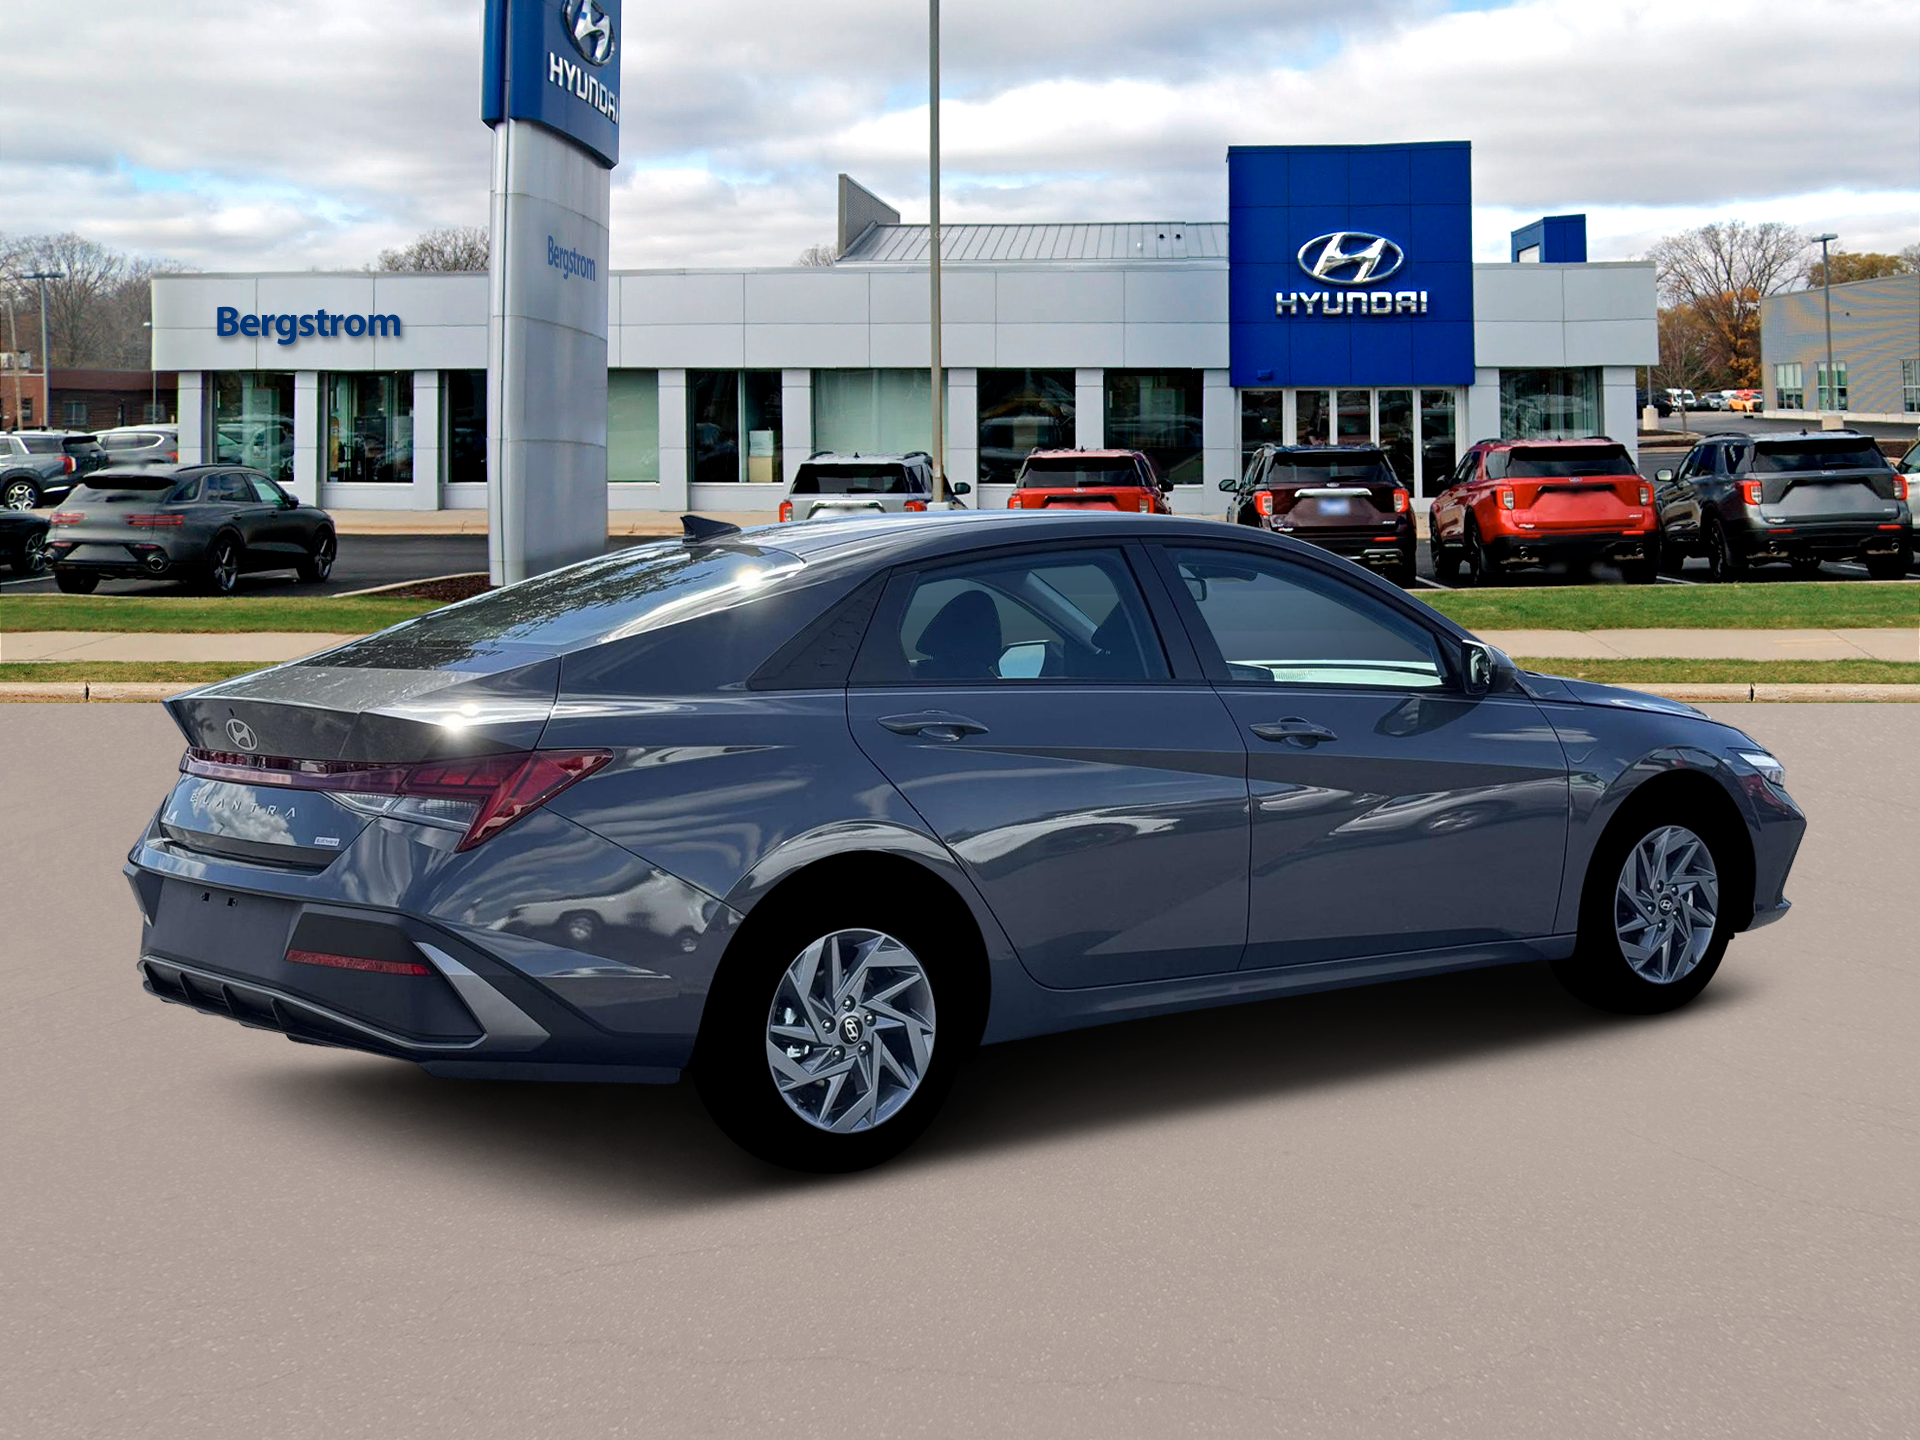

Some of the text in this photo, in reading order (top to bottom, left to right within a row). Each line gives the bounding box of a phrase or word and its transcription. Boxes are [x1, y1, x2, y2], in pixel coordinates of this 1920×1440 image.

[549, 52, 619, 124] HYUNDAI
[548, 235, 596, 282] Bergstrom
[1276, 291, 1428, 315] HYUNDAI
[217, 306, 401, 346] Bergstrom
[190, 793, 296, 819] ELANTRA
